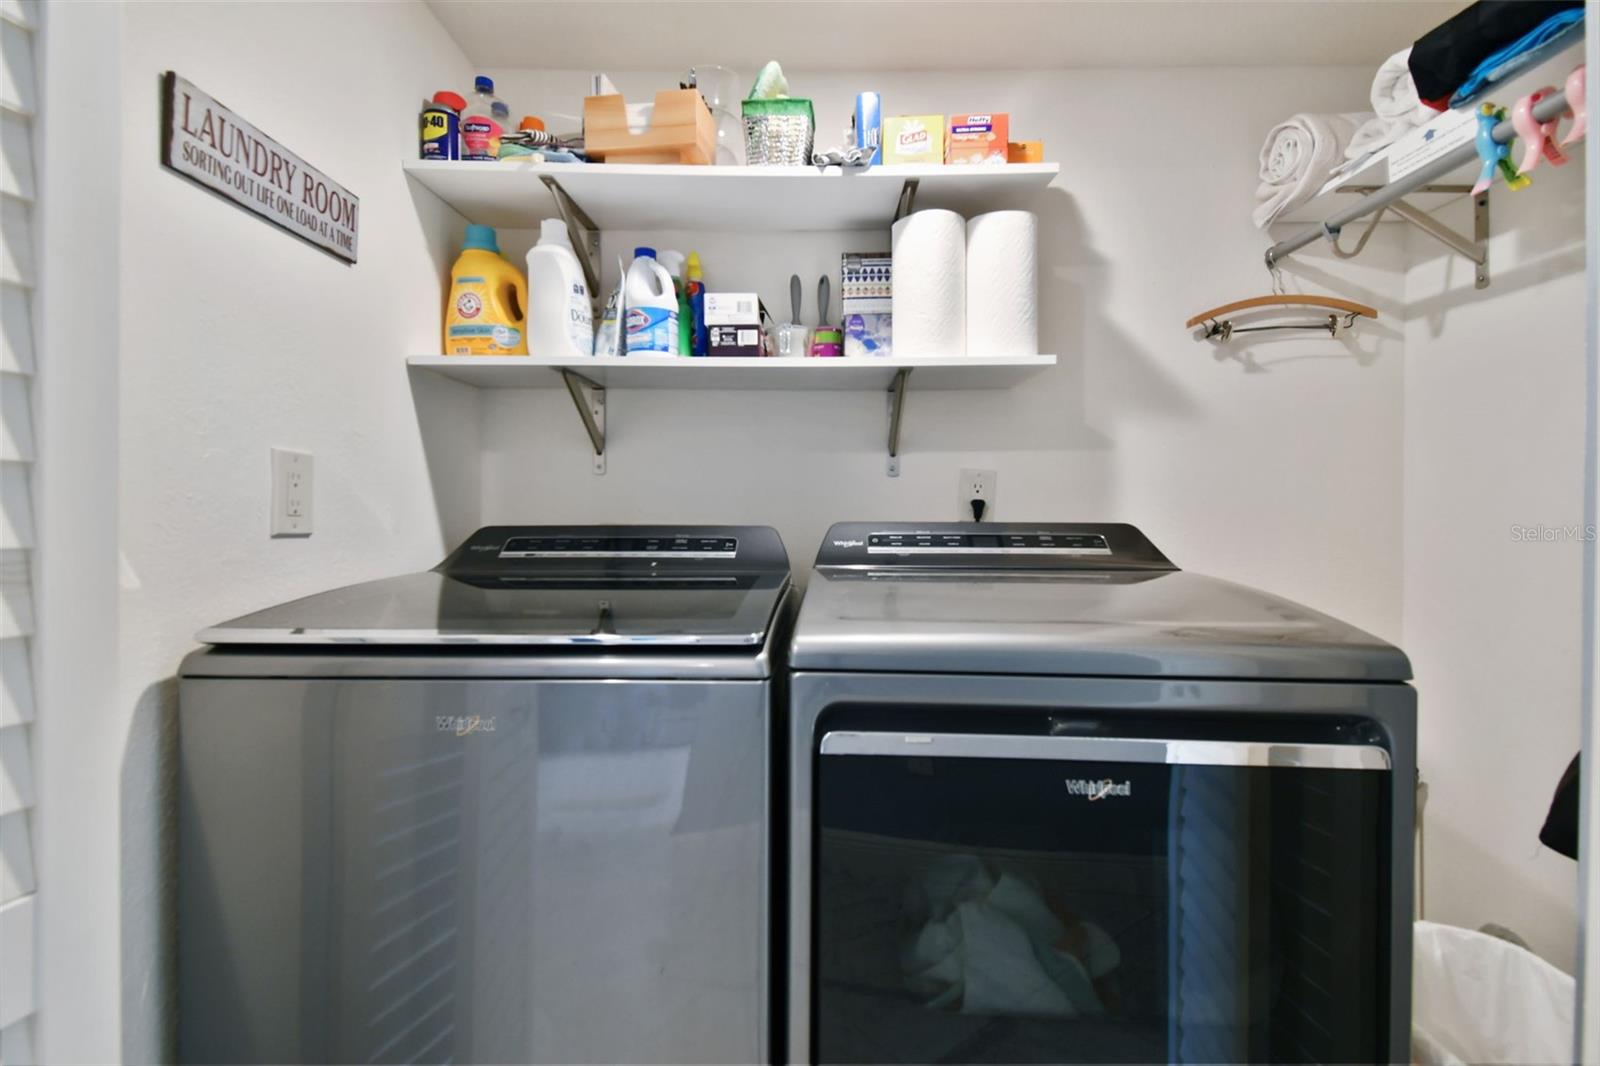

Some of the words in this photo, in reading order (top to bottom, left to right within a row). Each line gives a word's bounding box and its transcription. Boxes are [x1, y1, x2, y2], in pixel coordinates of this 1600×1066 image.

[181, 94, 296, 194] LAUNDRY
[302, 171, 356, 232] ROOM
[902, 132, 926, 143] GLAD
[182, 140, 233, 185] SORTING
[234, 170, 255, 197] OUT
[256, 185, 276, 209] LIFE
[276, 195, 294, 219] ONE
[296, 206, 318, 232] LOAD
[318, 221, 329, 238] AT
[329, 226, 336, 243] A
[336, 229, 354, 252] TIME
[1065, 778, 1131, 801] Whirlpool
